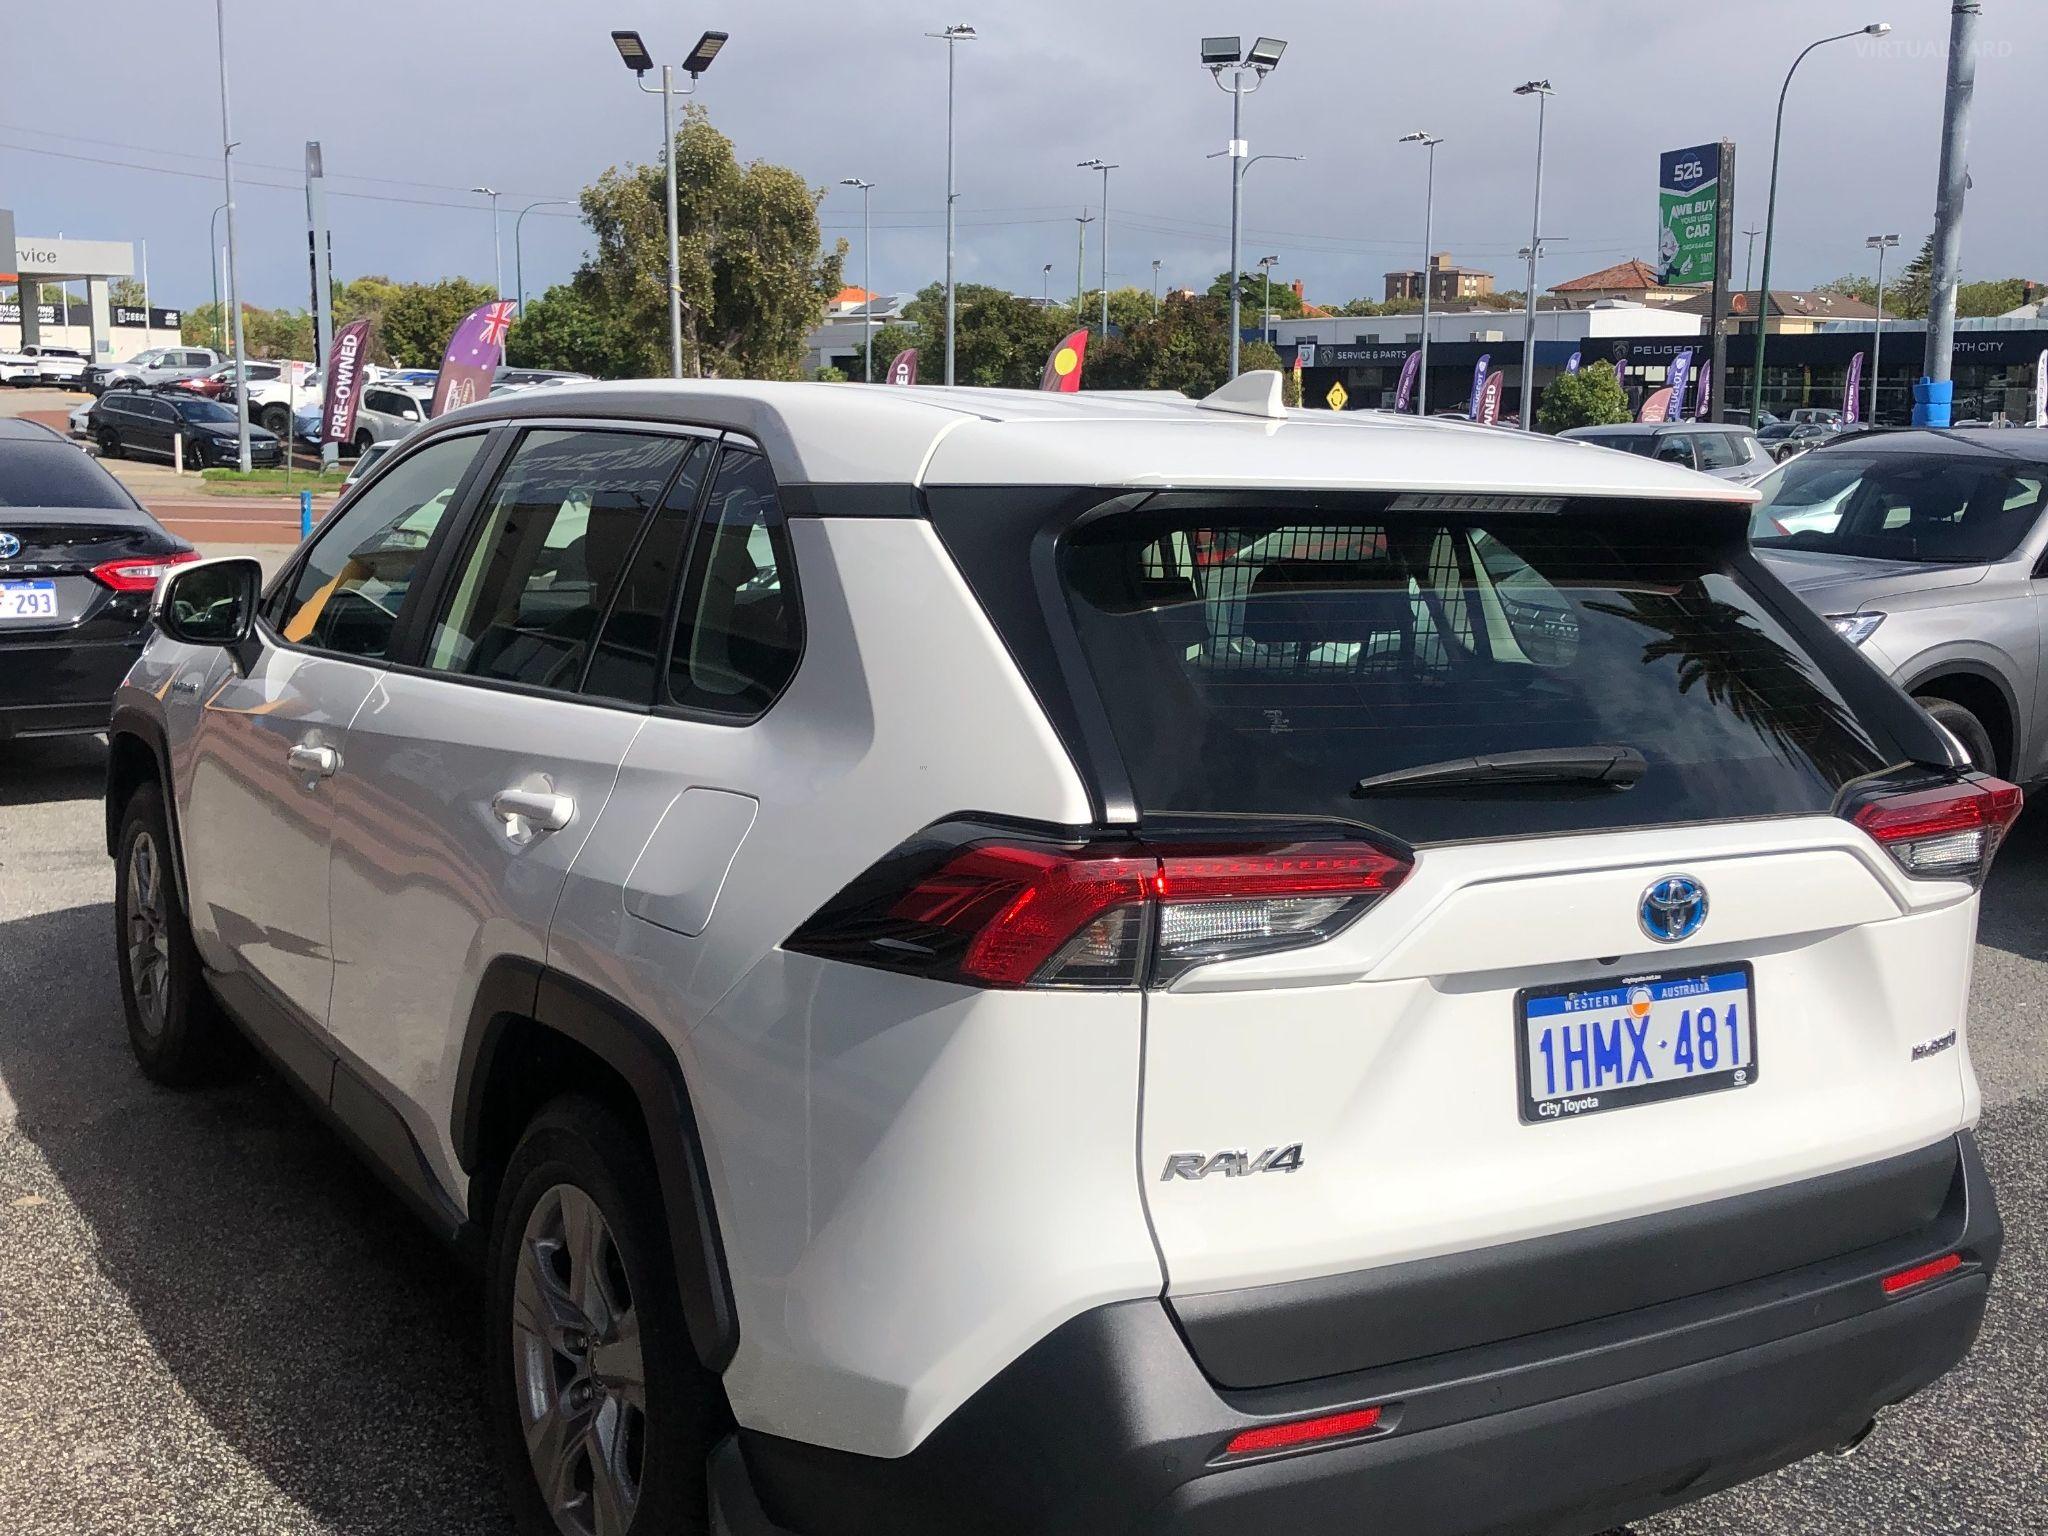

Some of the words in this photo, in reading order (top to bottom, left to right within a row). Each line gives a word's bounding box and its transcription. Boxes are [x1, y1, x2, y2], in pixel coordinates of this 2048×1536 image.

[1674, 161, 1703, 182] 526
[1695, 199, 1716, 213] BUY
[1685, 223, 1711, 239] CAR
[125, 312, 146, 321] ZEEK
[1337, 351, 1371, 360] SERVICE
[1380, 350, 1407, 359] PARTS
[1633, 345, 1704, 355] PEUGEOT
[1978, 341, 2004, 351] CITY
[896, 363, 909, 385] ED
[331, 334, 358, 438] PRE-OWNED
[1669, 370, 1683, 415] PEUGEOT
[16, 593, 52, 615] 293
[1564, 994, 1618, 1012] WESTERN
[1661, 982, 1710, 999] AUSTRALIA
[1538, 1101, 1561, 1117] City
[1562, 1096, 1599, 1114] Toyota
[1160, 1141, 1305, 1182] RAV4
